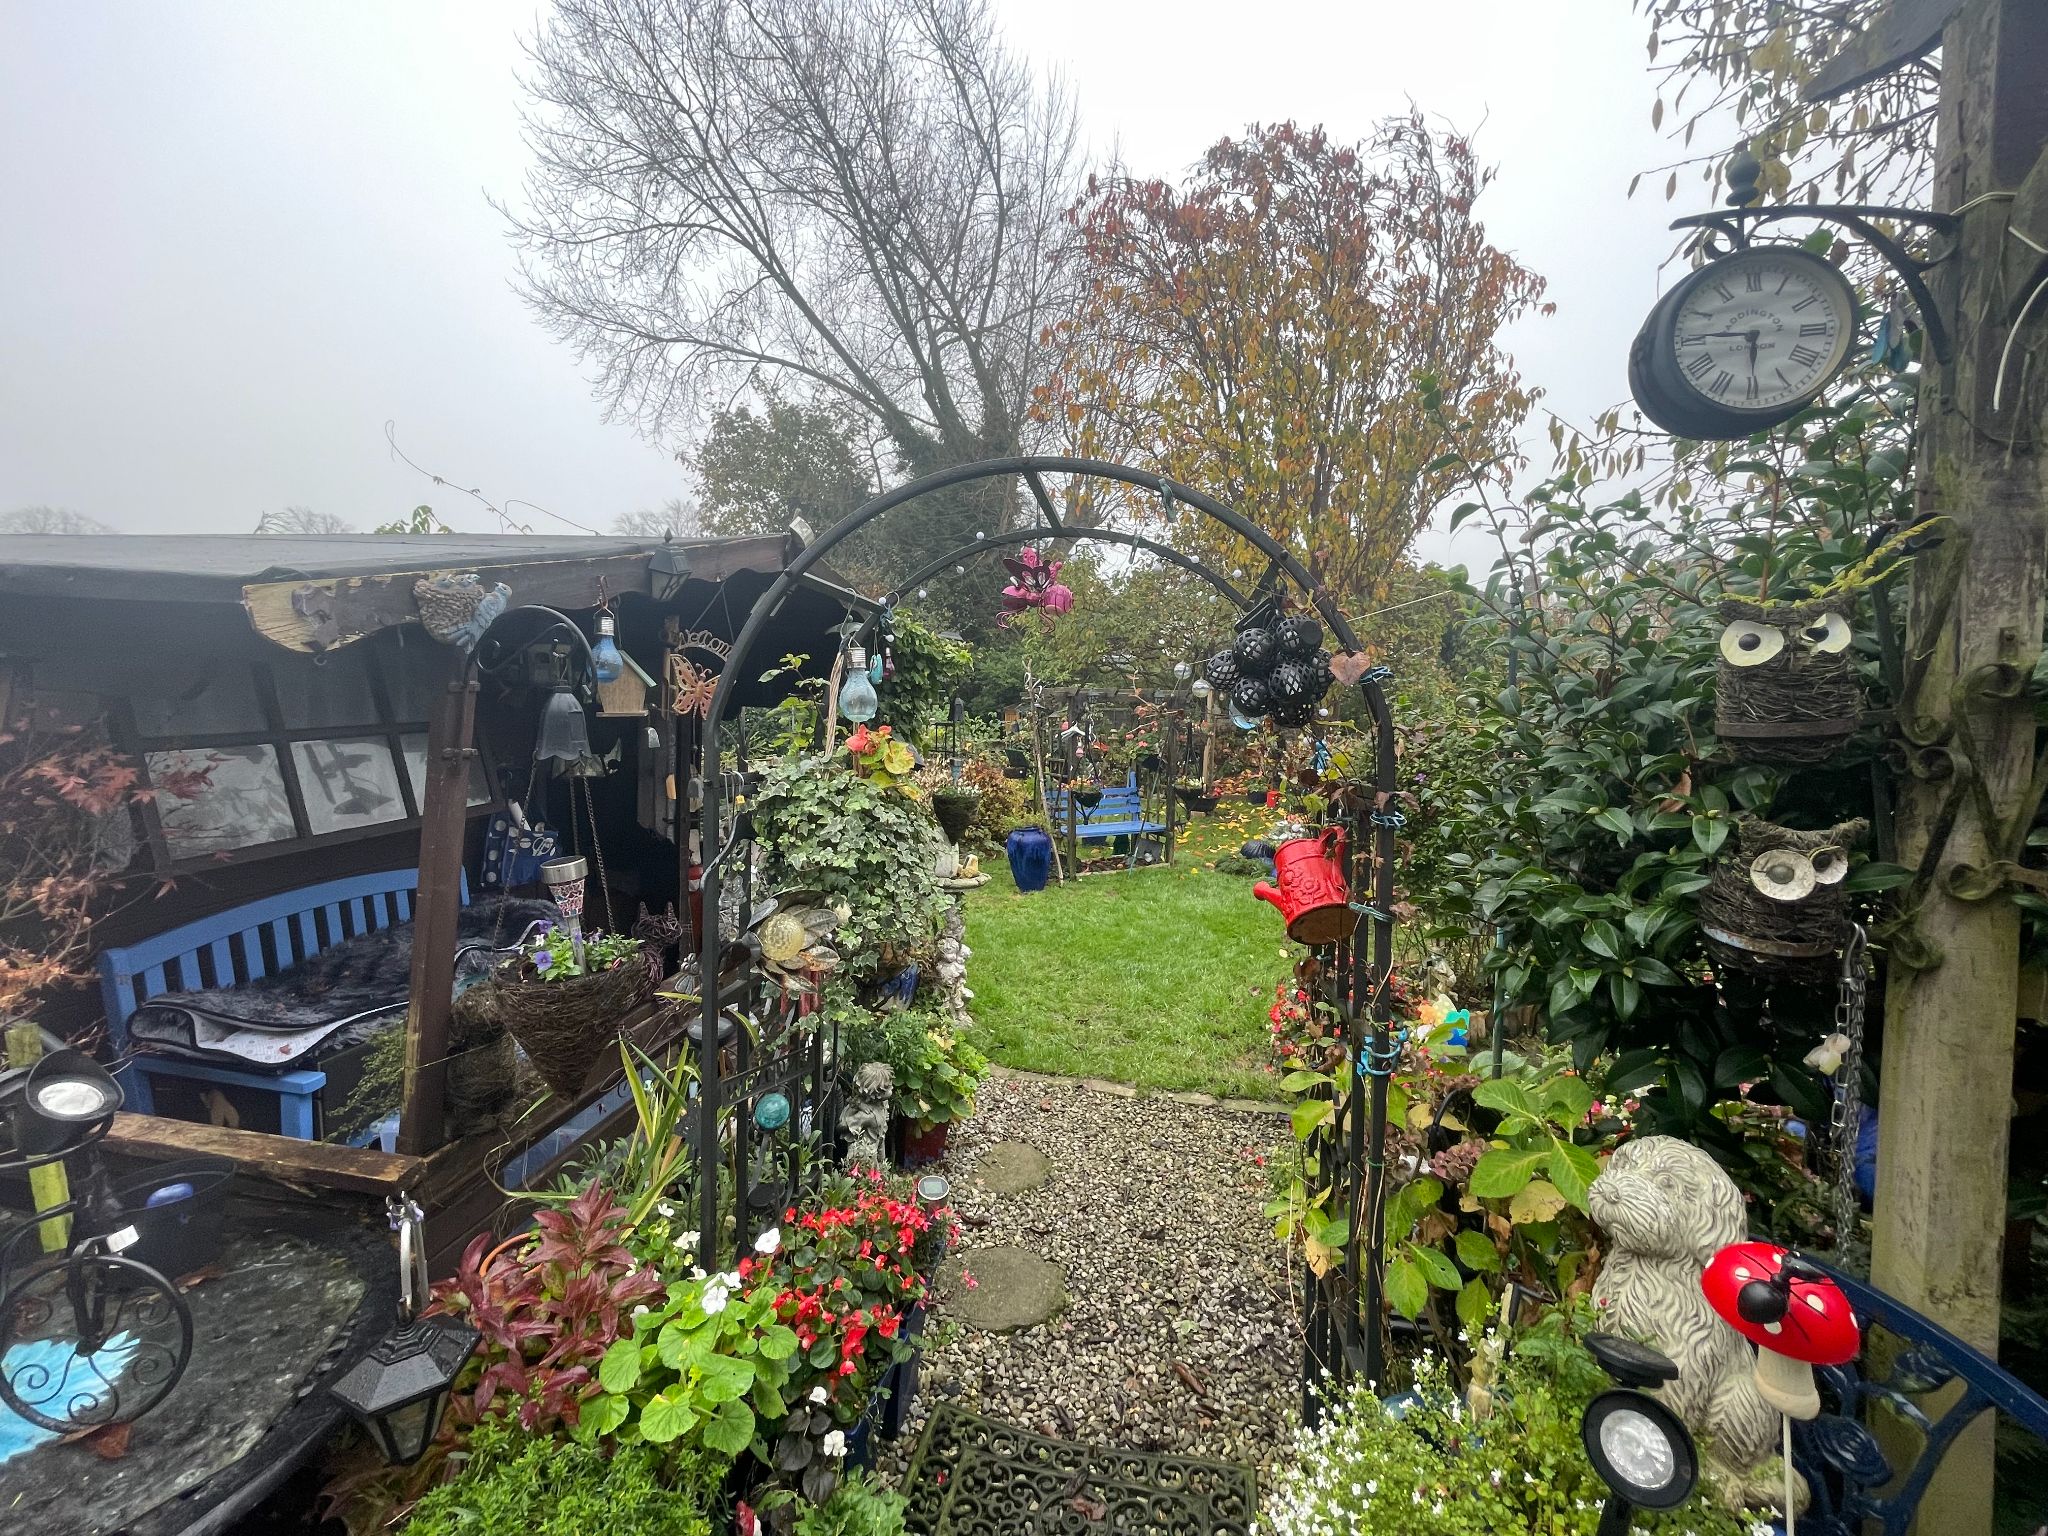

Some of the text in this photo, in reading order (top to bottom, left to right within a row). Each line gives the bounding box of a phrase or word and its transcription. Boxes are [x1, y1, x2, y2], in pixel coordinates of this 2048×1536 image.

[1747, 272, 1762, 292] XII
[1792, 295, 1818, 313] II
[1799, 322, 1828, 338] III
[1687, 352, 1717, 381] VIII
[1708, 369, 1735, 398] VII
[678, 628, 734, 659] Welcom
